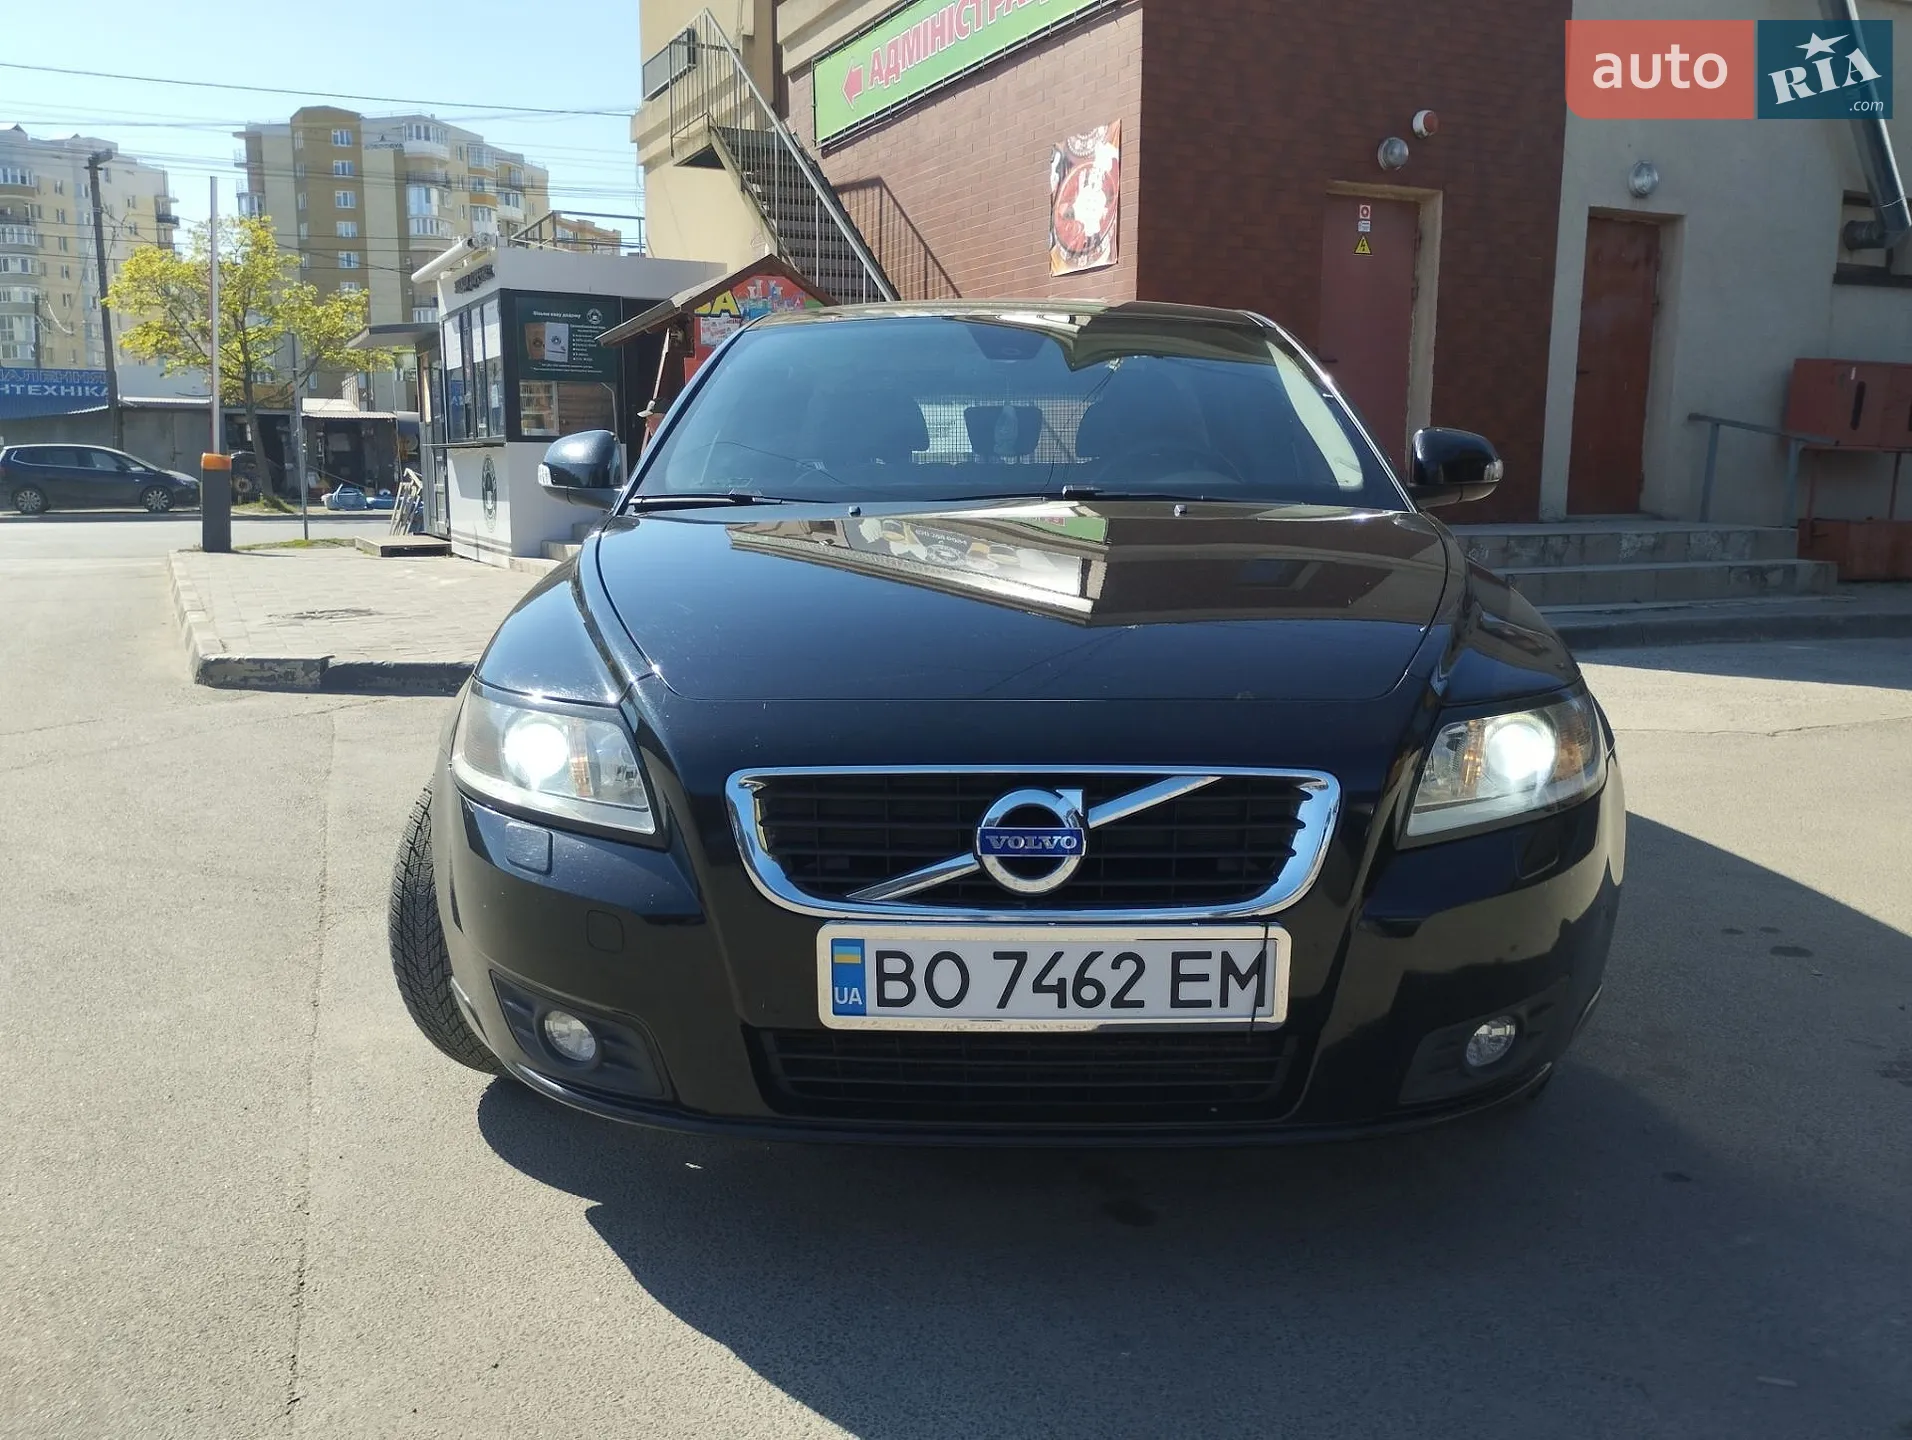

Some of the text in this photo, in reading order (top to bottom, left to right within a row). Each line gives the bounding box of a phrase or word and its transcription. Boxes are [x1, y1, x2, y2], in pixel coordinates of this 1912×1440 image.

[985, 835, 1078, 850] VOLVO
[875, 949, 1266, 1009] BO 7462 EM
[833, 986, 863, 1005] UA
